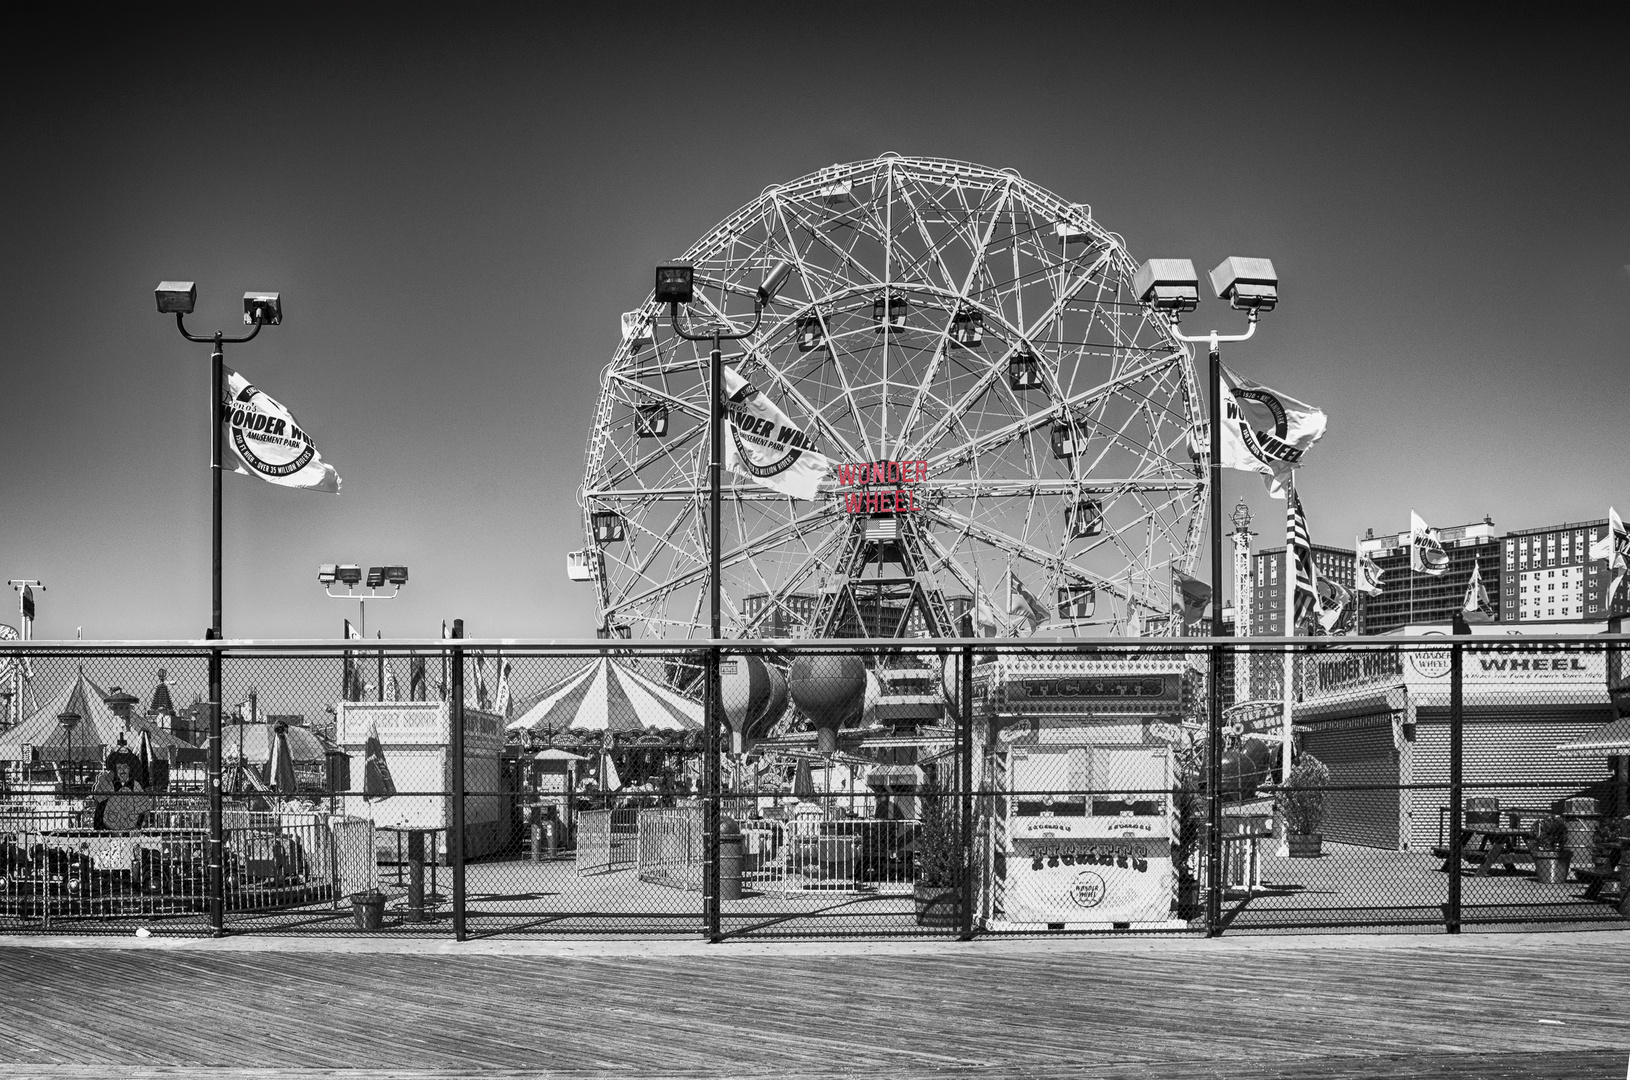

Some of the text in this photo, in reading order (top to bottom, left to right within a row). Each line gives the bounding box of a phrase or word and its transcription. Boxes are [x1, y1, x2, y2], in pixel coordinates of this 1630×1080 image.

[246, 431, 301, 449] AMUSEMENT PARK
[768, 440, 786, 452] PARK
[244, 450, 255, 463] HIGH
[256, 461, 269, 472] OVER
[270, 466, 277, 474] 35
[277, 462, 297, 474] MILLION
[295, 450, 312, 468] RIDERS
[838, 460, 927, 485] WONDER
[845, 490, 921, 513] WHEEL
[1480, 659, 1586, 671] WHEEL
[1023, 679, 1165, 697] TICKETS
